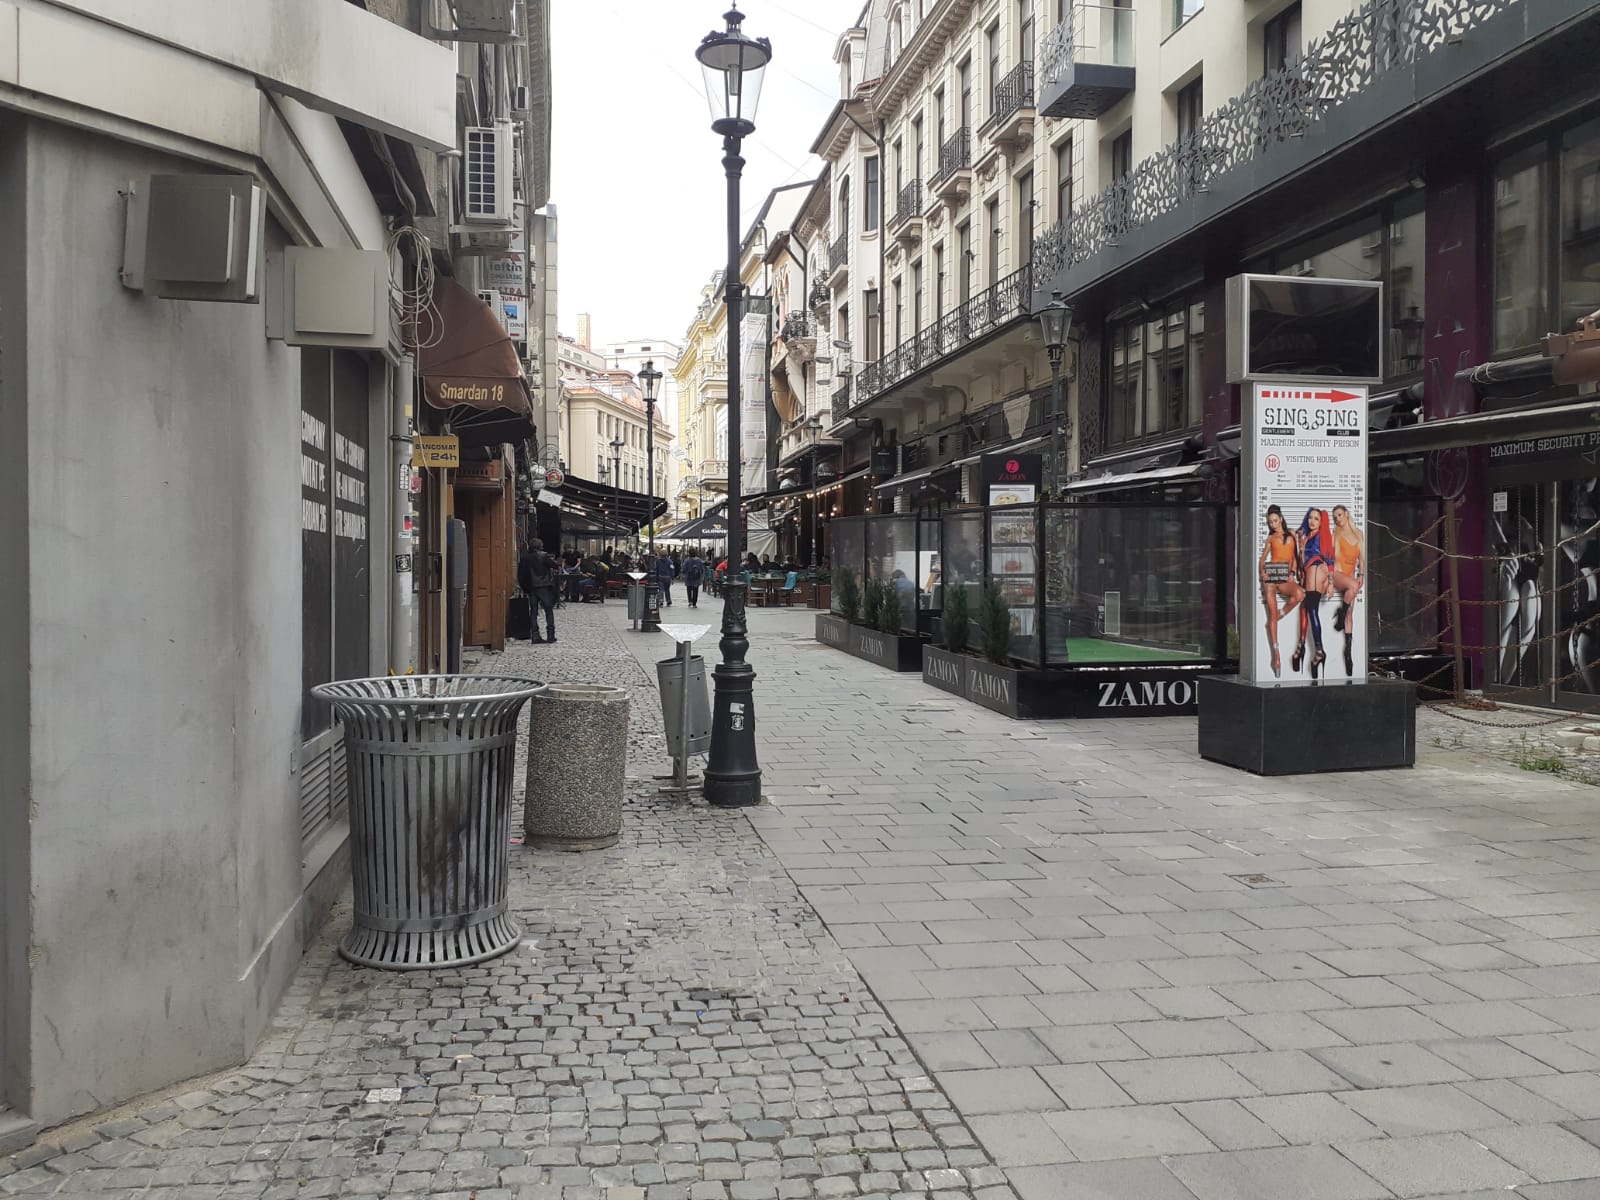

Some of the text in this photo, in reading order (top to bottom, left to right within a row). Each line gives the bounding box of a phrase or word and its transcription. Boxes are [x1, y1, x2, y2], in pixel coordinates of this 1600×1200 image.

[439, 382, 504, 401] Smardan 18
[1264, 407, 1358, 427] SING SING
[1260, 438, 1360, 448] MAXIMUM SECURITY PRISON
[1490, 440, 1535, 457] MAXIMUM
[1537, 434, 1586, 451] SECURITY
[430, 452, 457, 461] 24h
[1285, 455, 1339, 464] VISITING HOURS
[860, 635, 884, 657] ZAMON
[927, 655, 959, 687] ZAMON
[970, 669, 1010, 705] ZAMON
